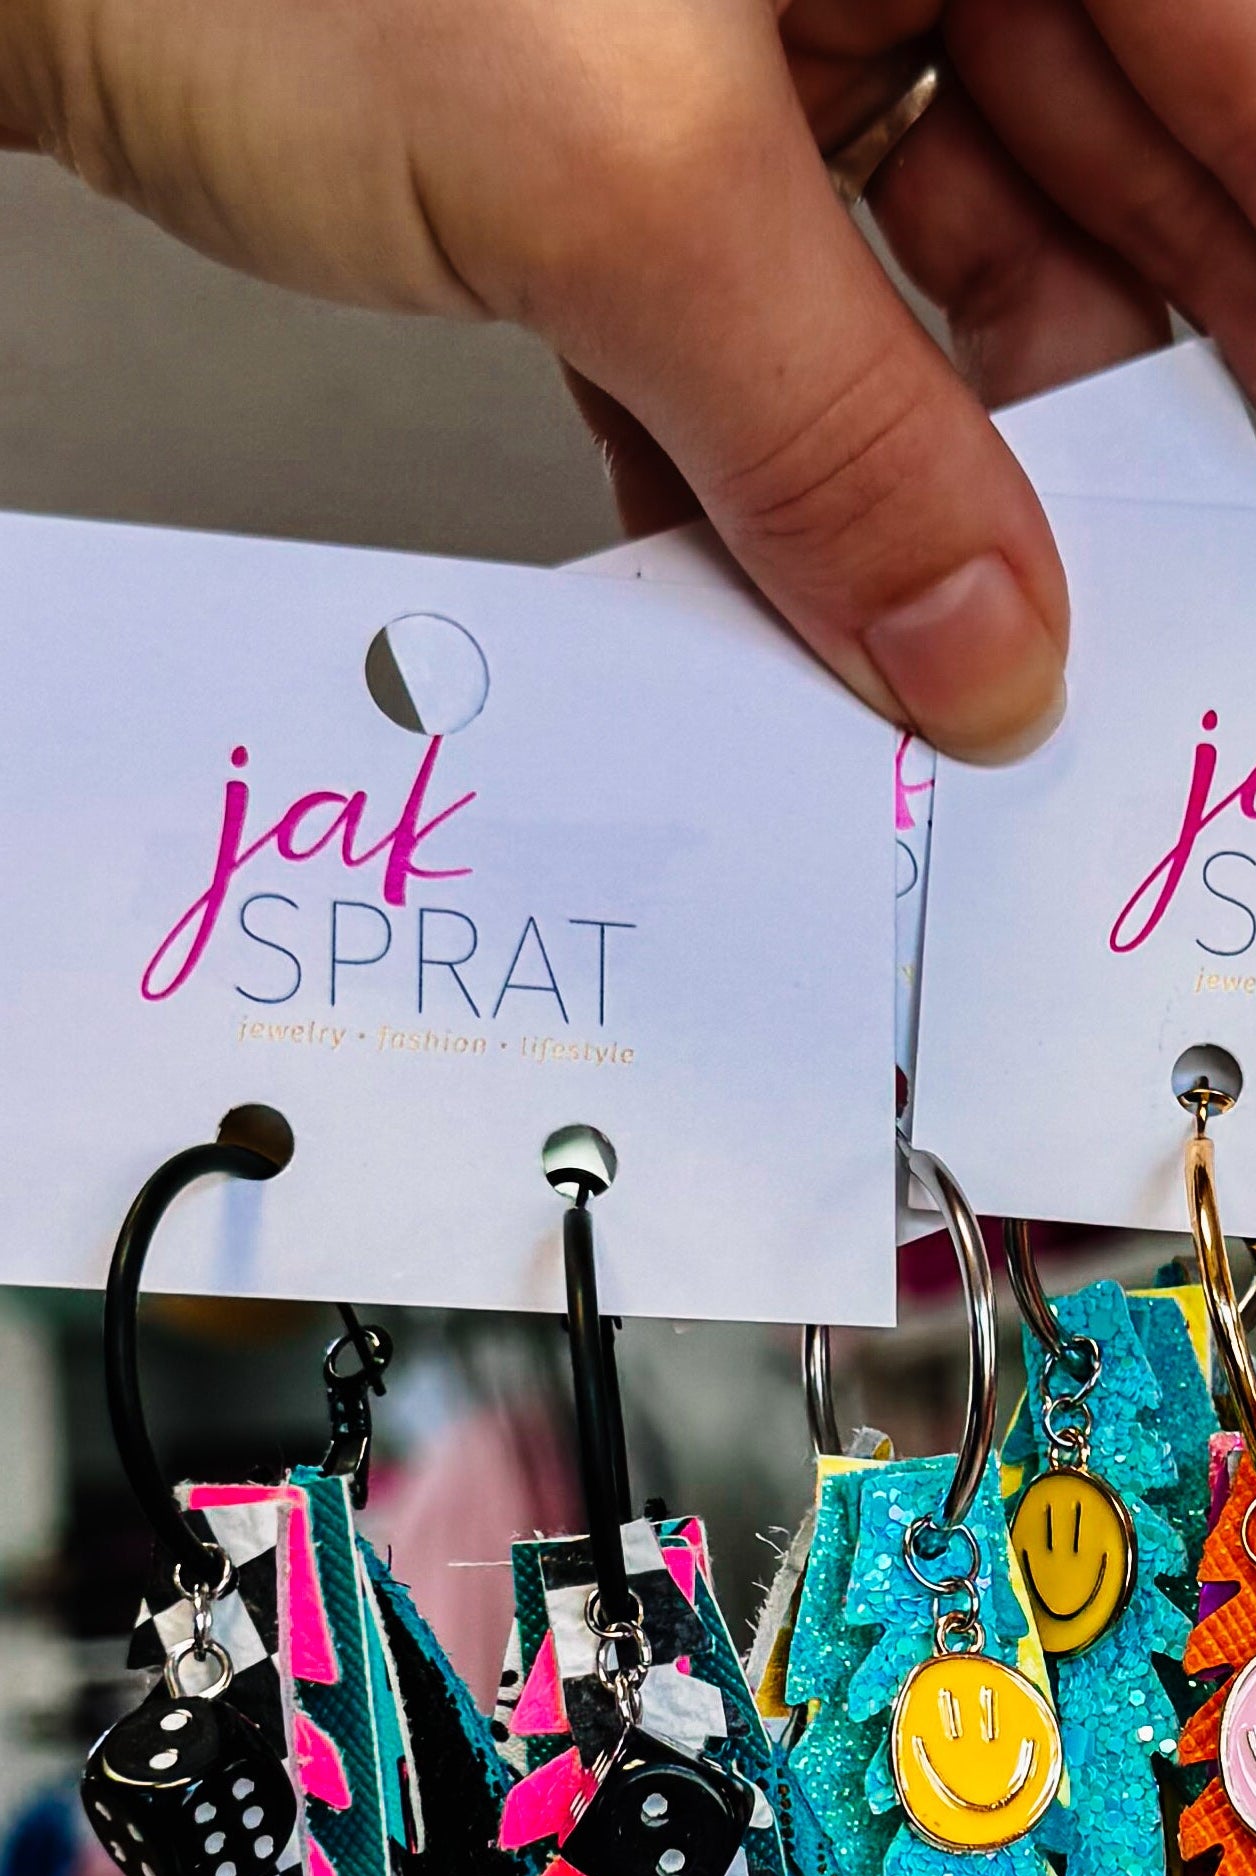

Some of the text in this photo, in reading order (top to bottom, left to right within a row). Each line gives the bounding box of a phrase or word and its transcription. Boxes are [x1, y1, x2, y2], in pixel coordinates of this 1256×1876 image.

[141, 733, 477, 1000] jak
[235, 893, 637, 1026] SPRAT
[238, 1018, 636, 1066] jewelry fashion lifestyle
